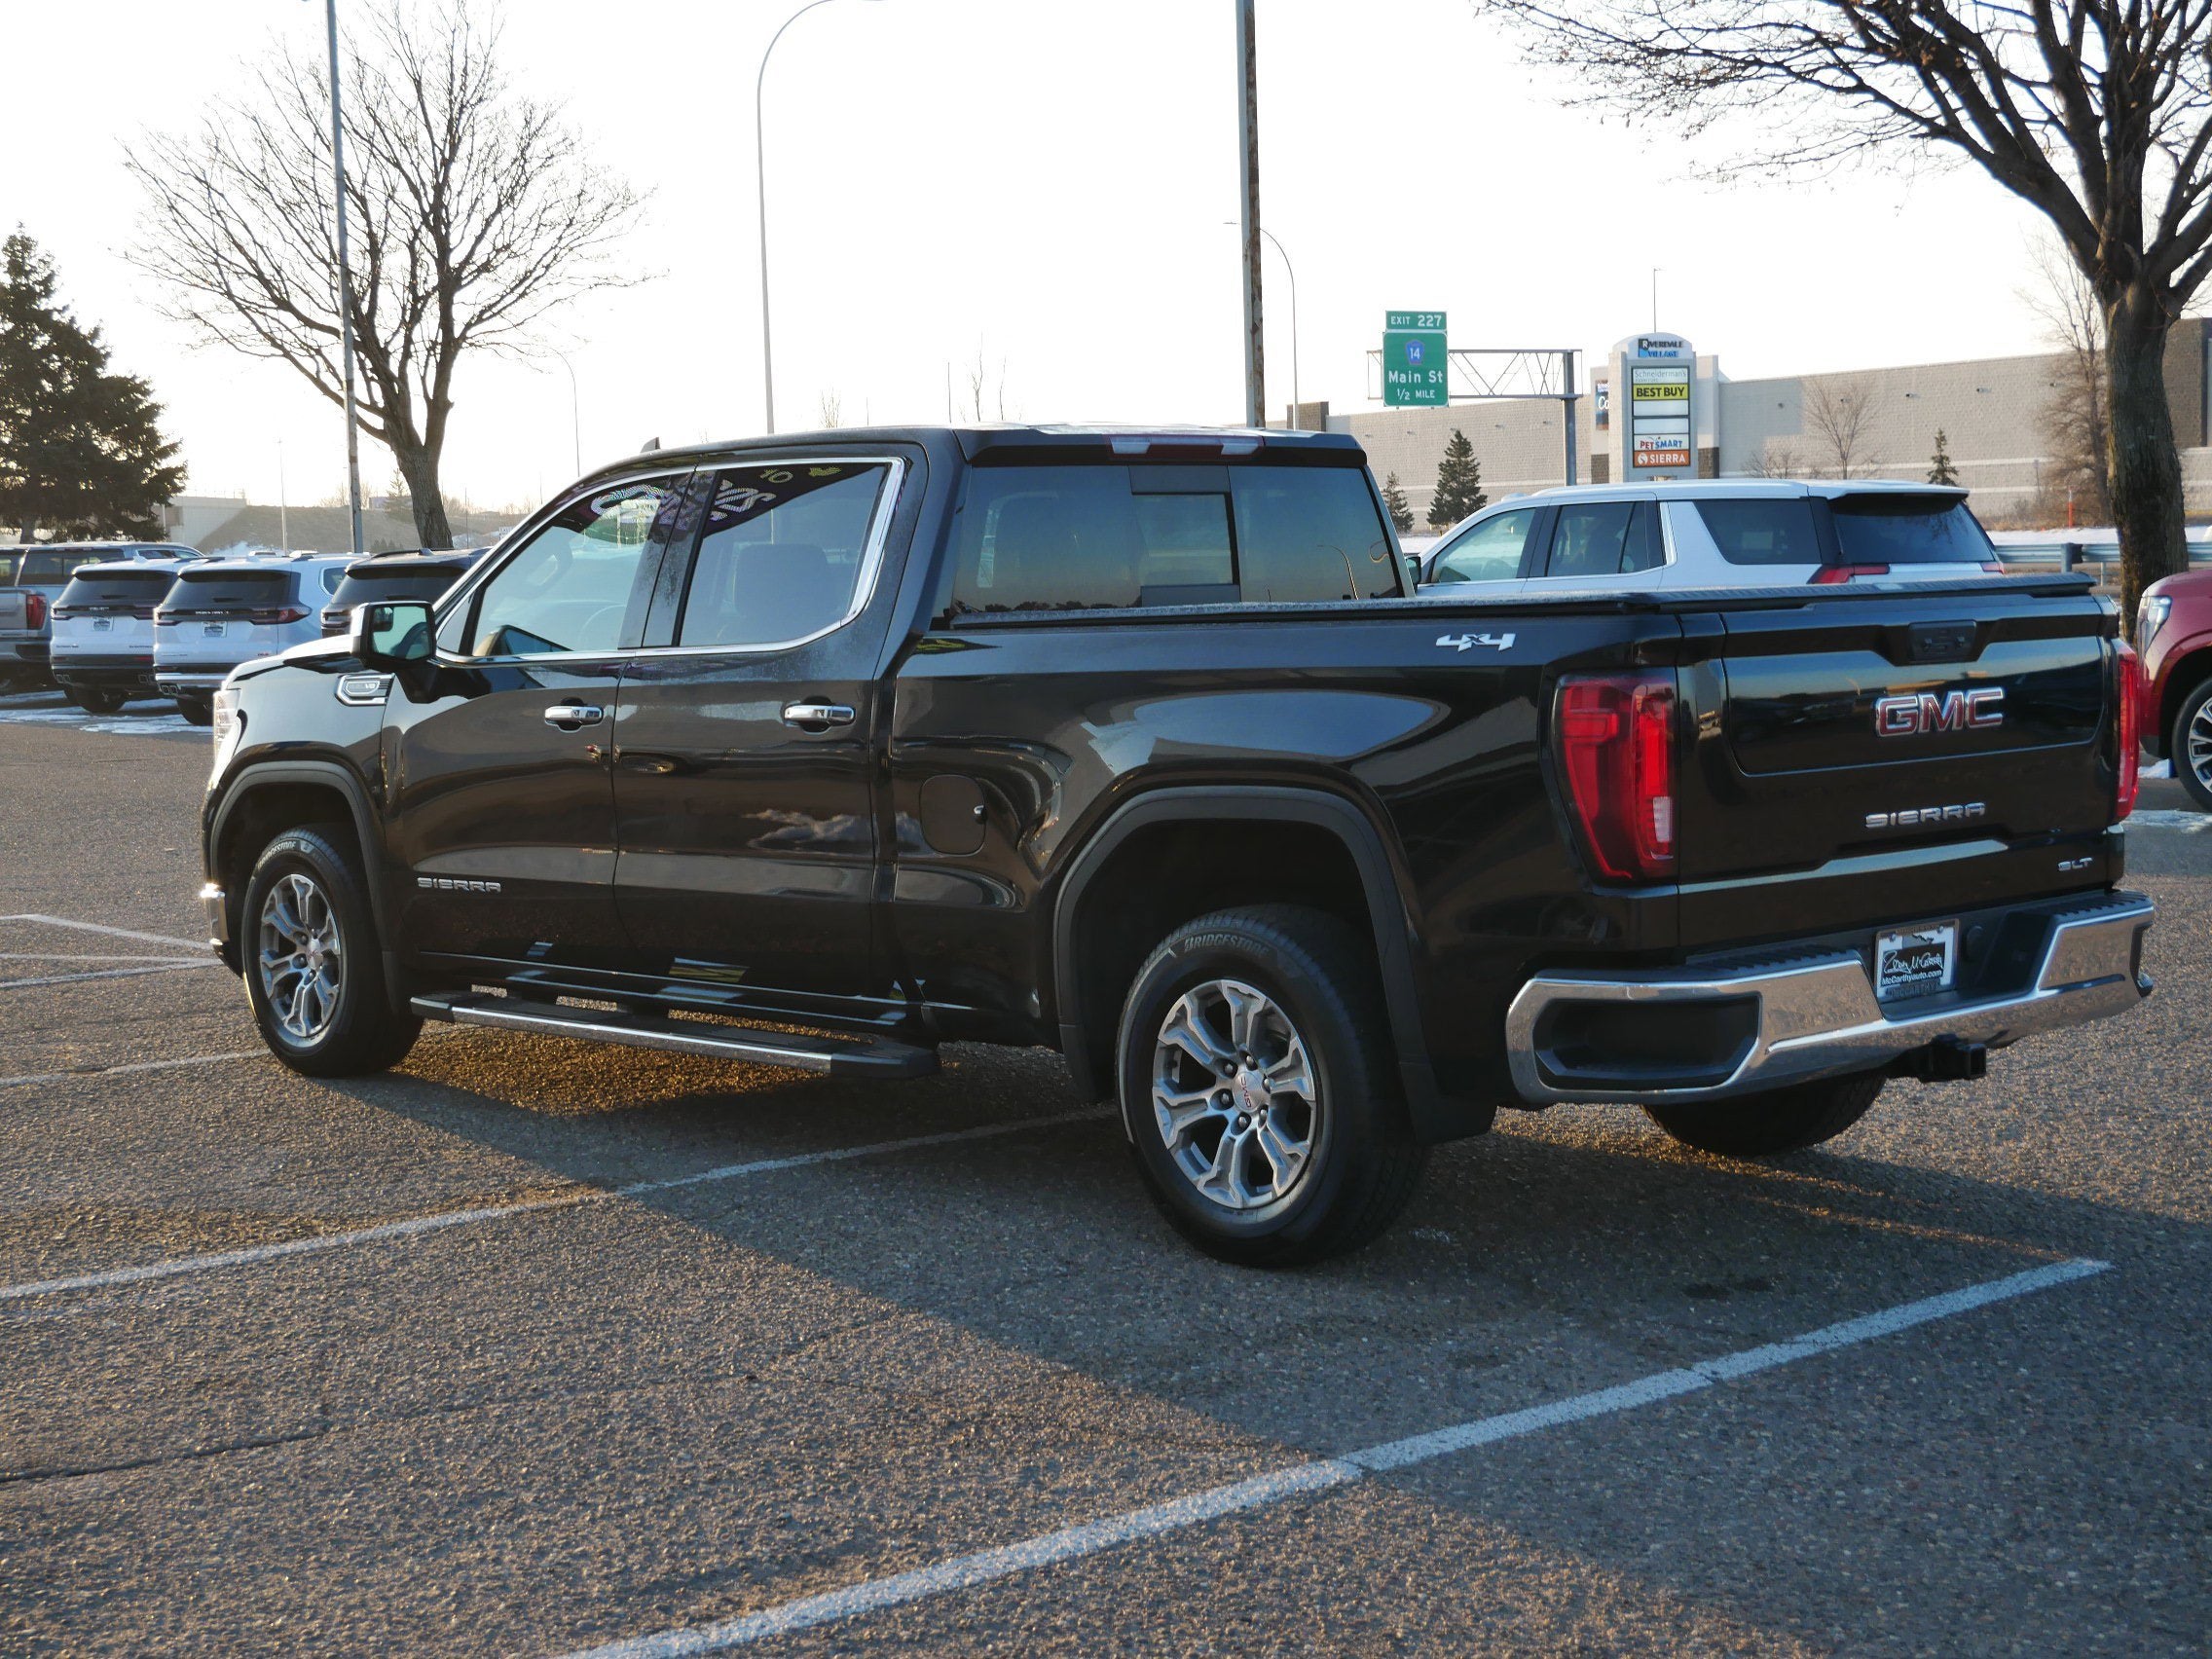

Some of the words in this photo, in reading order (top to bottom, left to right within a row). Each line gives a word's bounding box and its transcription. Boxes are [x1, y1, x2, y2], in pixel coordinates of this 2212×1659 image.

[1390, 315, 1411, 325] EXIT
[1418, 314, 1442, 327] 227
[1642, 340, 1683, 349] RIVERDALE
[1409, 348, 1420, 359] 14
[1388, 370, 1421, 384] Main
[1428, 370, 1443, 384] St
[1415, 389, 1436, 399] MILE
[1636, 387, 1662, 397] BEST
[1664, 387, 1685, 397] BUY
[1649, 453, 1686, 464] SIERRA
[1875, 686, 2006, 738] GMC
[1865, 801, 1986, 829] SIERRA
[2057, 857, 2093, 871] SLT
[417, 876, 501, 894] SIERRA
[1881, 970, 1942, 985] McCarthyauto.com
